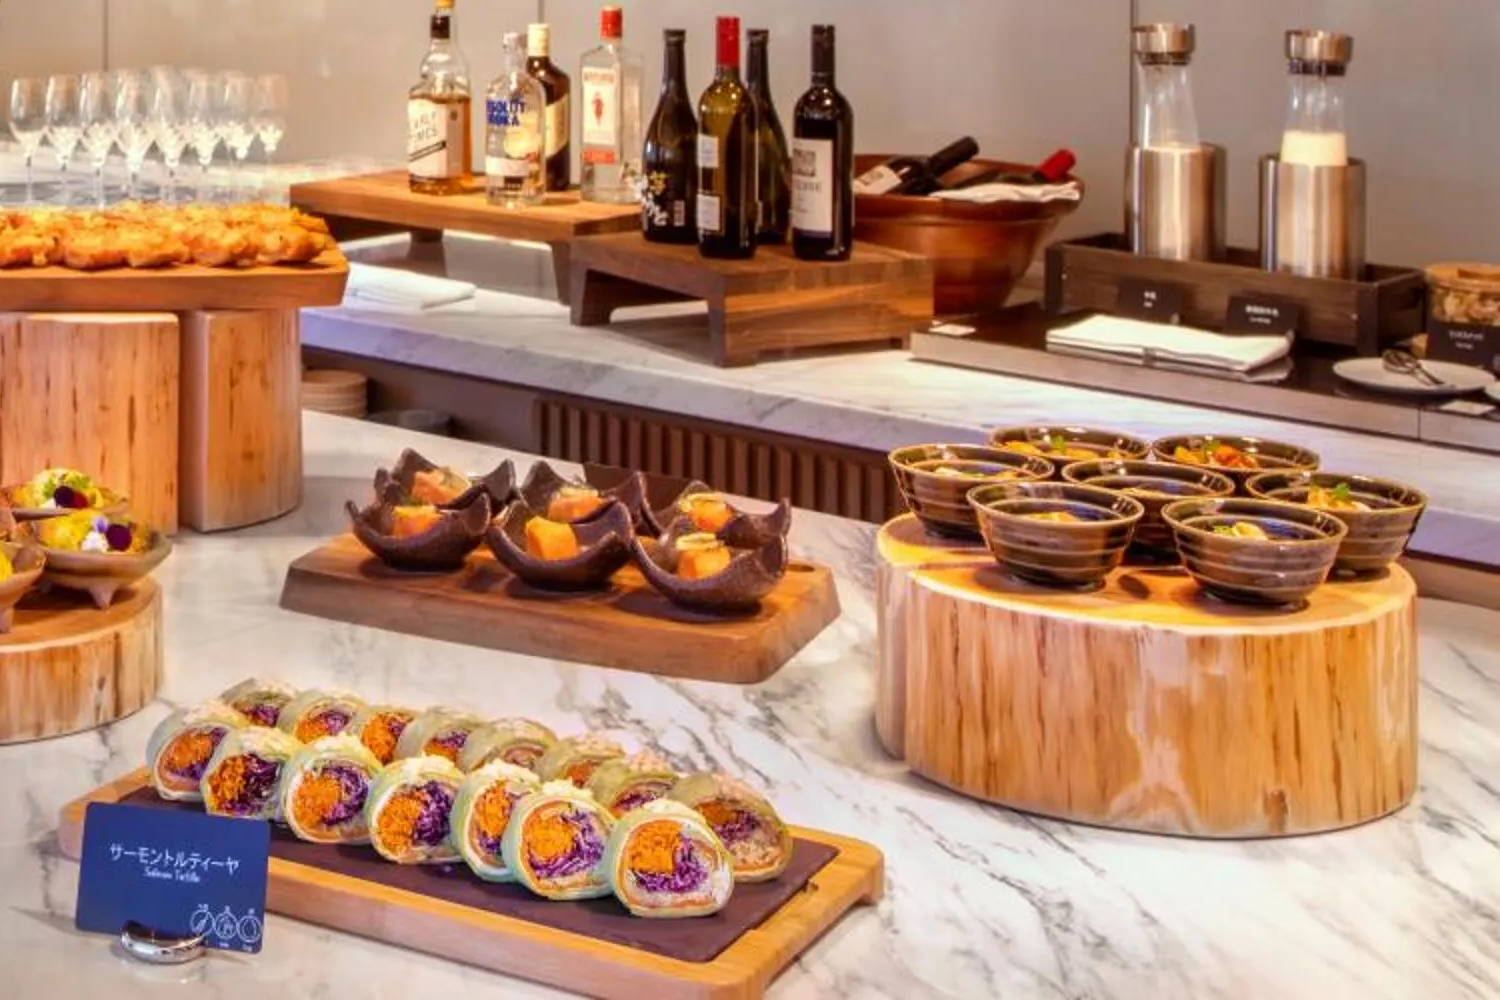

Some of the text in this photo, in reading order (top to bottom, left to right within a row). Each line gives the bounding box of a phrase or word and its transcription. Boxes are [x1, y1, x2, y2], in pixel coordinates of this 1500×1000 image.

[109, 843, 240, 875] サーモントルティーヤ
